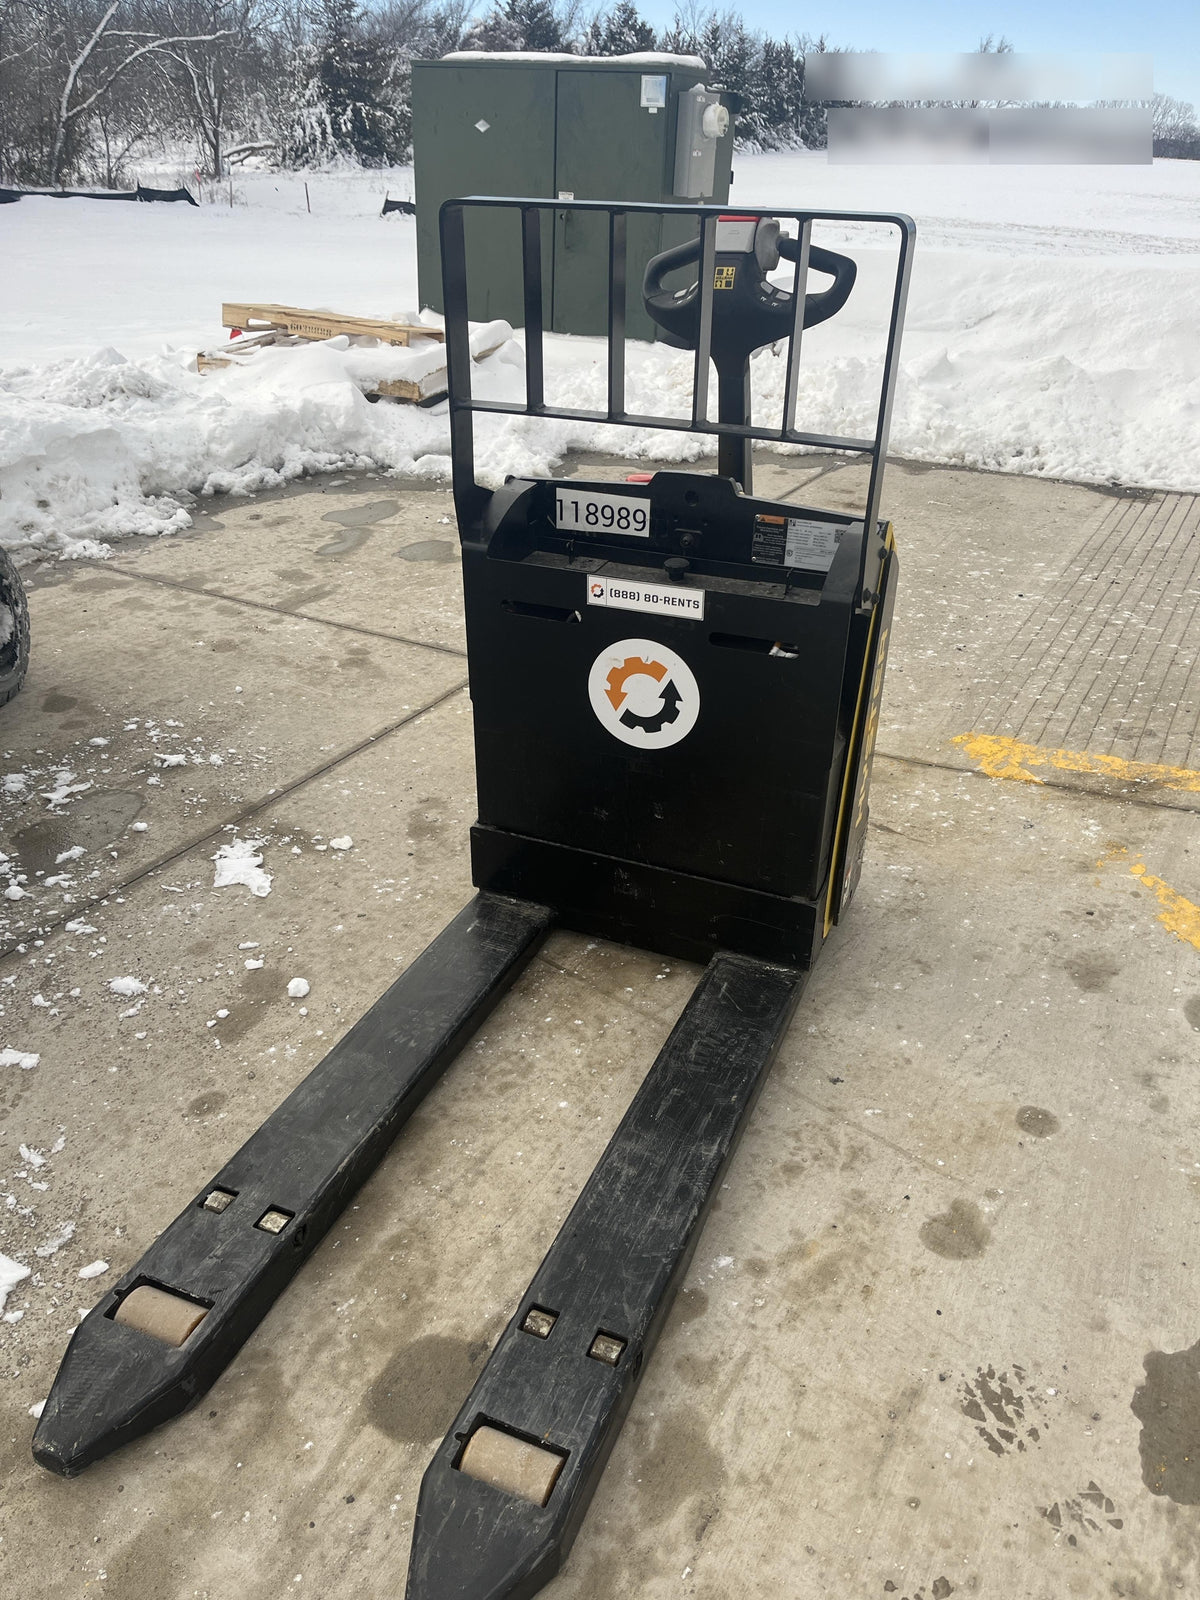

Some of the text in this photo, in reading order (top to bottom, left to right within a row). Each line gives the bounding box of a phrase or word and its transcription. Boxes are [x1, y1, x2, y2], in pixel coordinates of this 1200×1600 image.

[557, 499, 647, 532] 118989
[609, 587, 700, 609] (888) 80-RENTS
